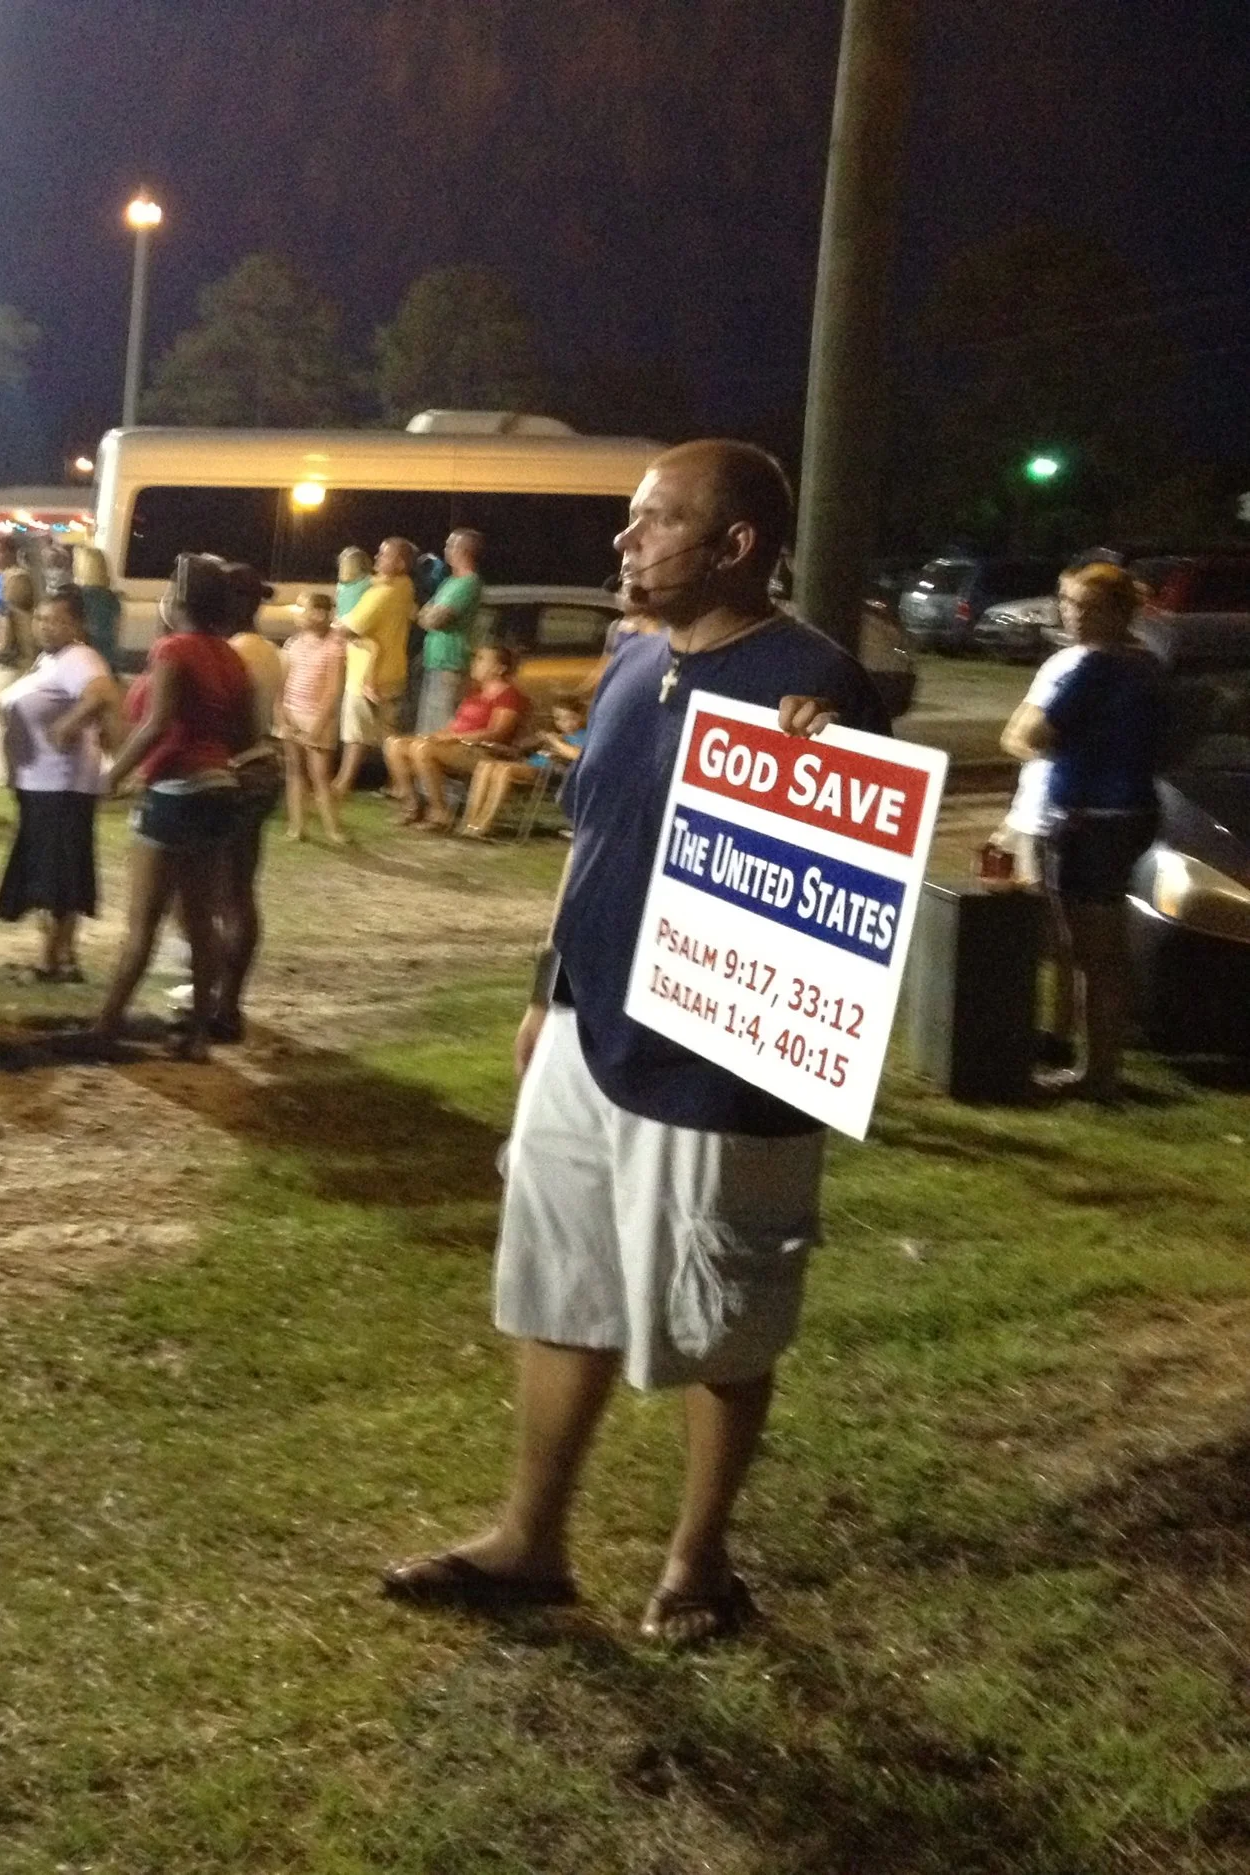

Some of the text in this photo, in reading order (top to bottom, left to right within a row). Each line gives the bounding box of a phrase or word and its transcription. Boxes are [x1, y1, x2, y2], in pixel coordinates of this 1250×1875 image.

[698, 727, 906, 835] GOD SAVE
[669, 817, 895, 950] THE UNITED STATES
[650, 965, 849, 1089] ISAIAH 1:4, 40:15
[656, 917, 865, 1039] PSALM 9:17, 33:12
